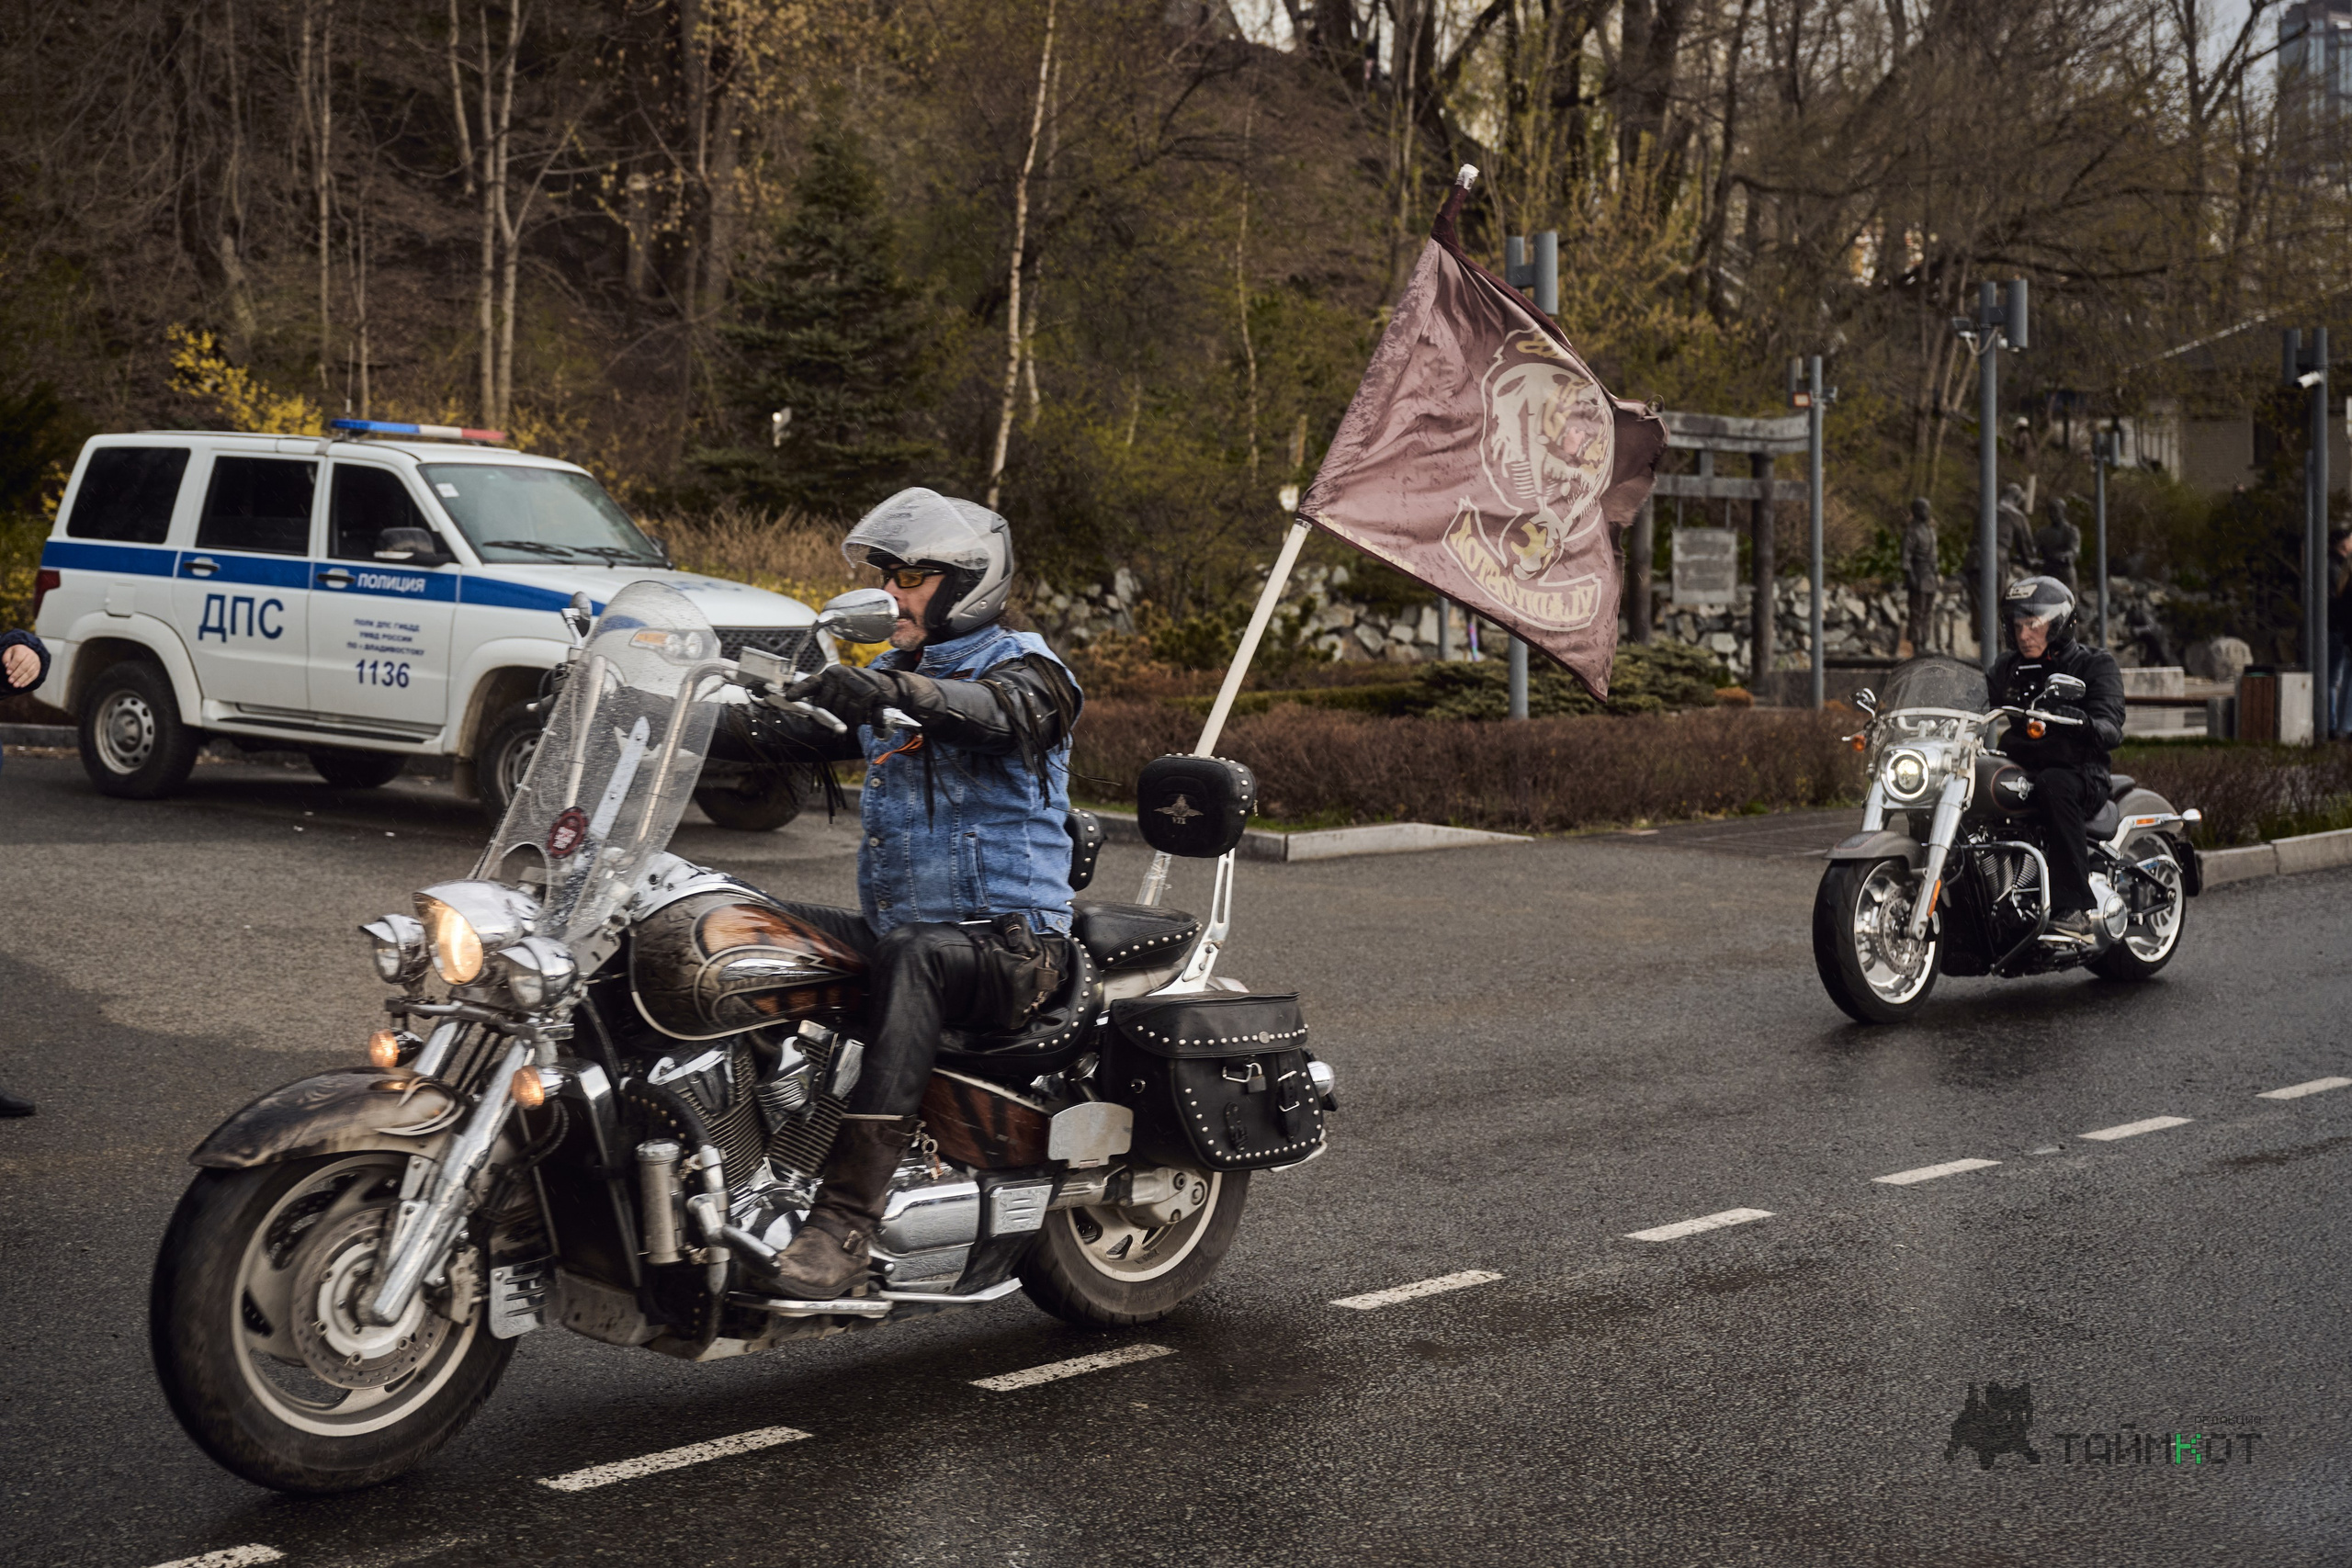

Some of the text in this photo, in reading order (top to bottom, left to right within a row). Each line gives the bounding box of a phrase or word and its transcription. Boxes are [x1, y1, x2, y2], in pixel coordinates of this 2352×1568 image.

[357, 573, 425, 592] ПОЛИЦИЯ
[198, 593, 284, 643] ДПС
[356, 659, 410, 688] 1136
